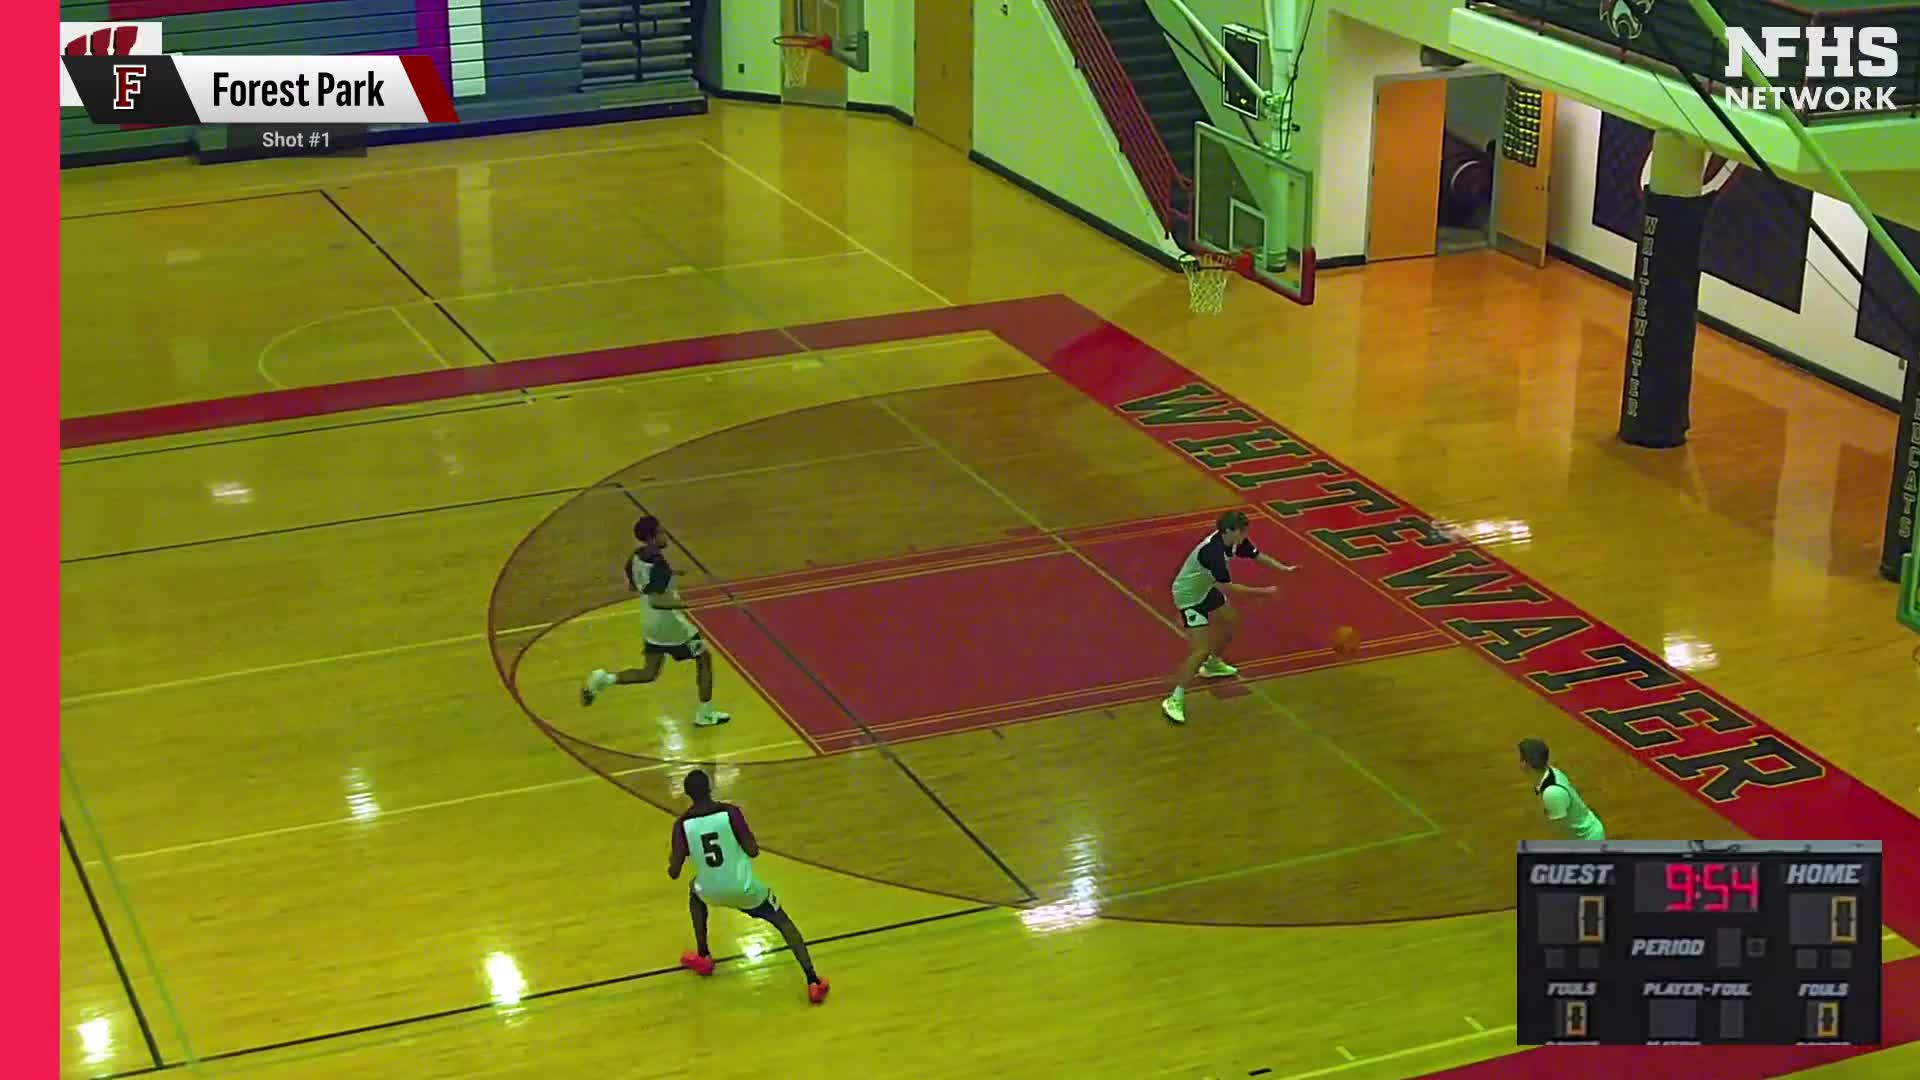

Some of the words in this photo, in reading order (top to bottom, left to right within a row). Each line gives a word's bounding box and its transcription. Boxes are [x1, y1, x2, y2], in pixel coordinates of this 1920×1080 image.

[1117, 381, 1827, 805] WHITEWATER
[700, 831, 724, 867] 5
[1530, 864, 1614, 885] GUEST
[1787, 864, 1862, 885] HOME
[1665, 864, 1759, 912] 9:54
[1631, 938, 1706, 957] PERIOD
[1546, 981, 1597, 996] FOULS
[1798, 983, 1849, 997] FOULS
